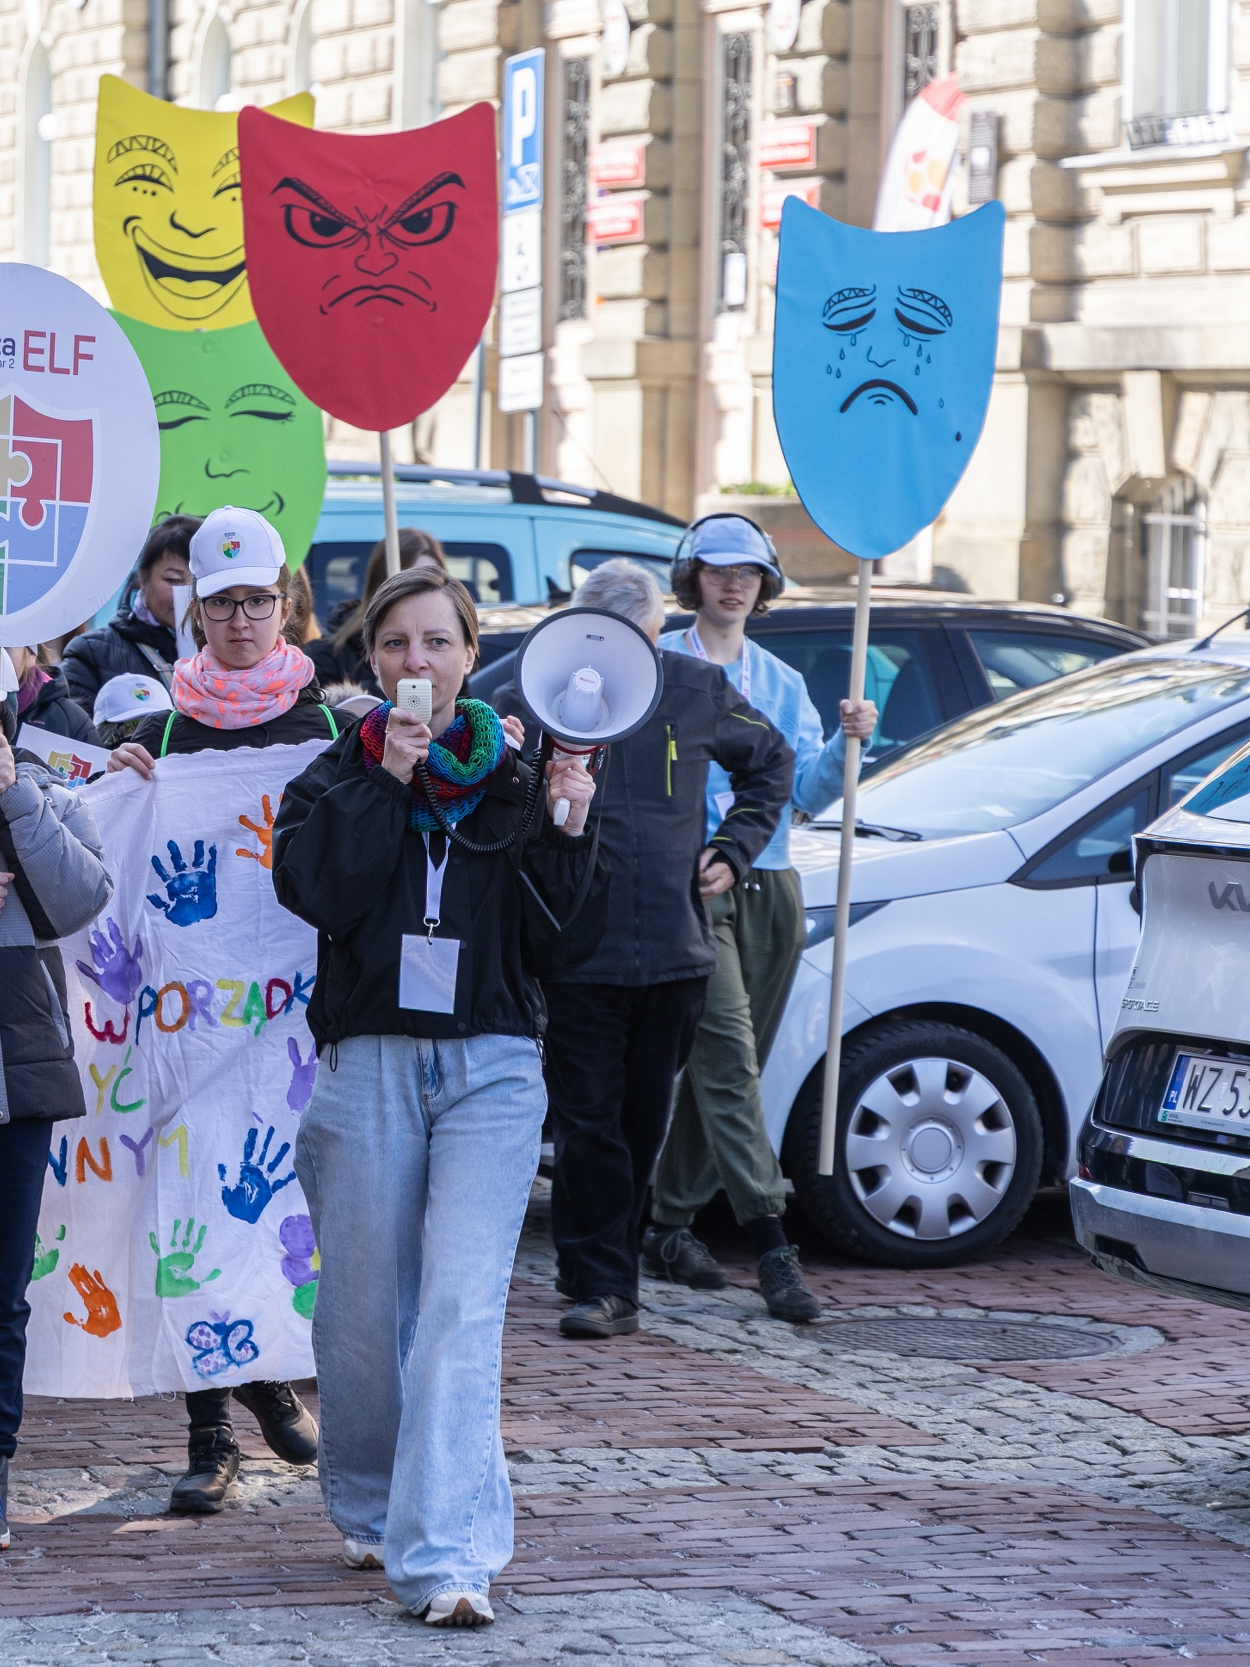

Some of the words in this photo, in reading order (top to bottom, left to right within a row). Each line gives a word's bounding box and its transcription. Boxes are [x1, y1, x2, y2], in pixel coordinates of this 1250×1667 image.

[511, 67, 537, 167] P
[8, 358, 15, 369] 2
[23, 329, 97, 376] ELF
[84, 1001, 130, 1045] W
[135, 971, 316, 1046] PORZĄDK
[1168, 1090, 1177, 1104] PL
[1182, 1062, 1225, 1112] WZ
